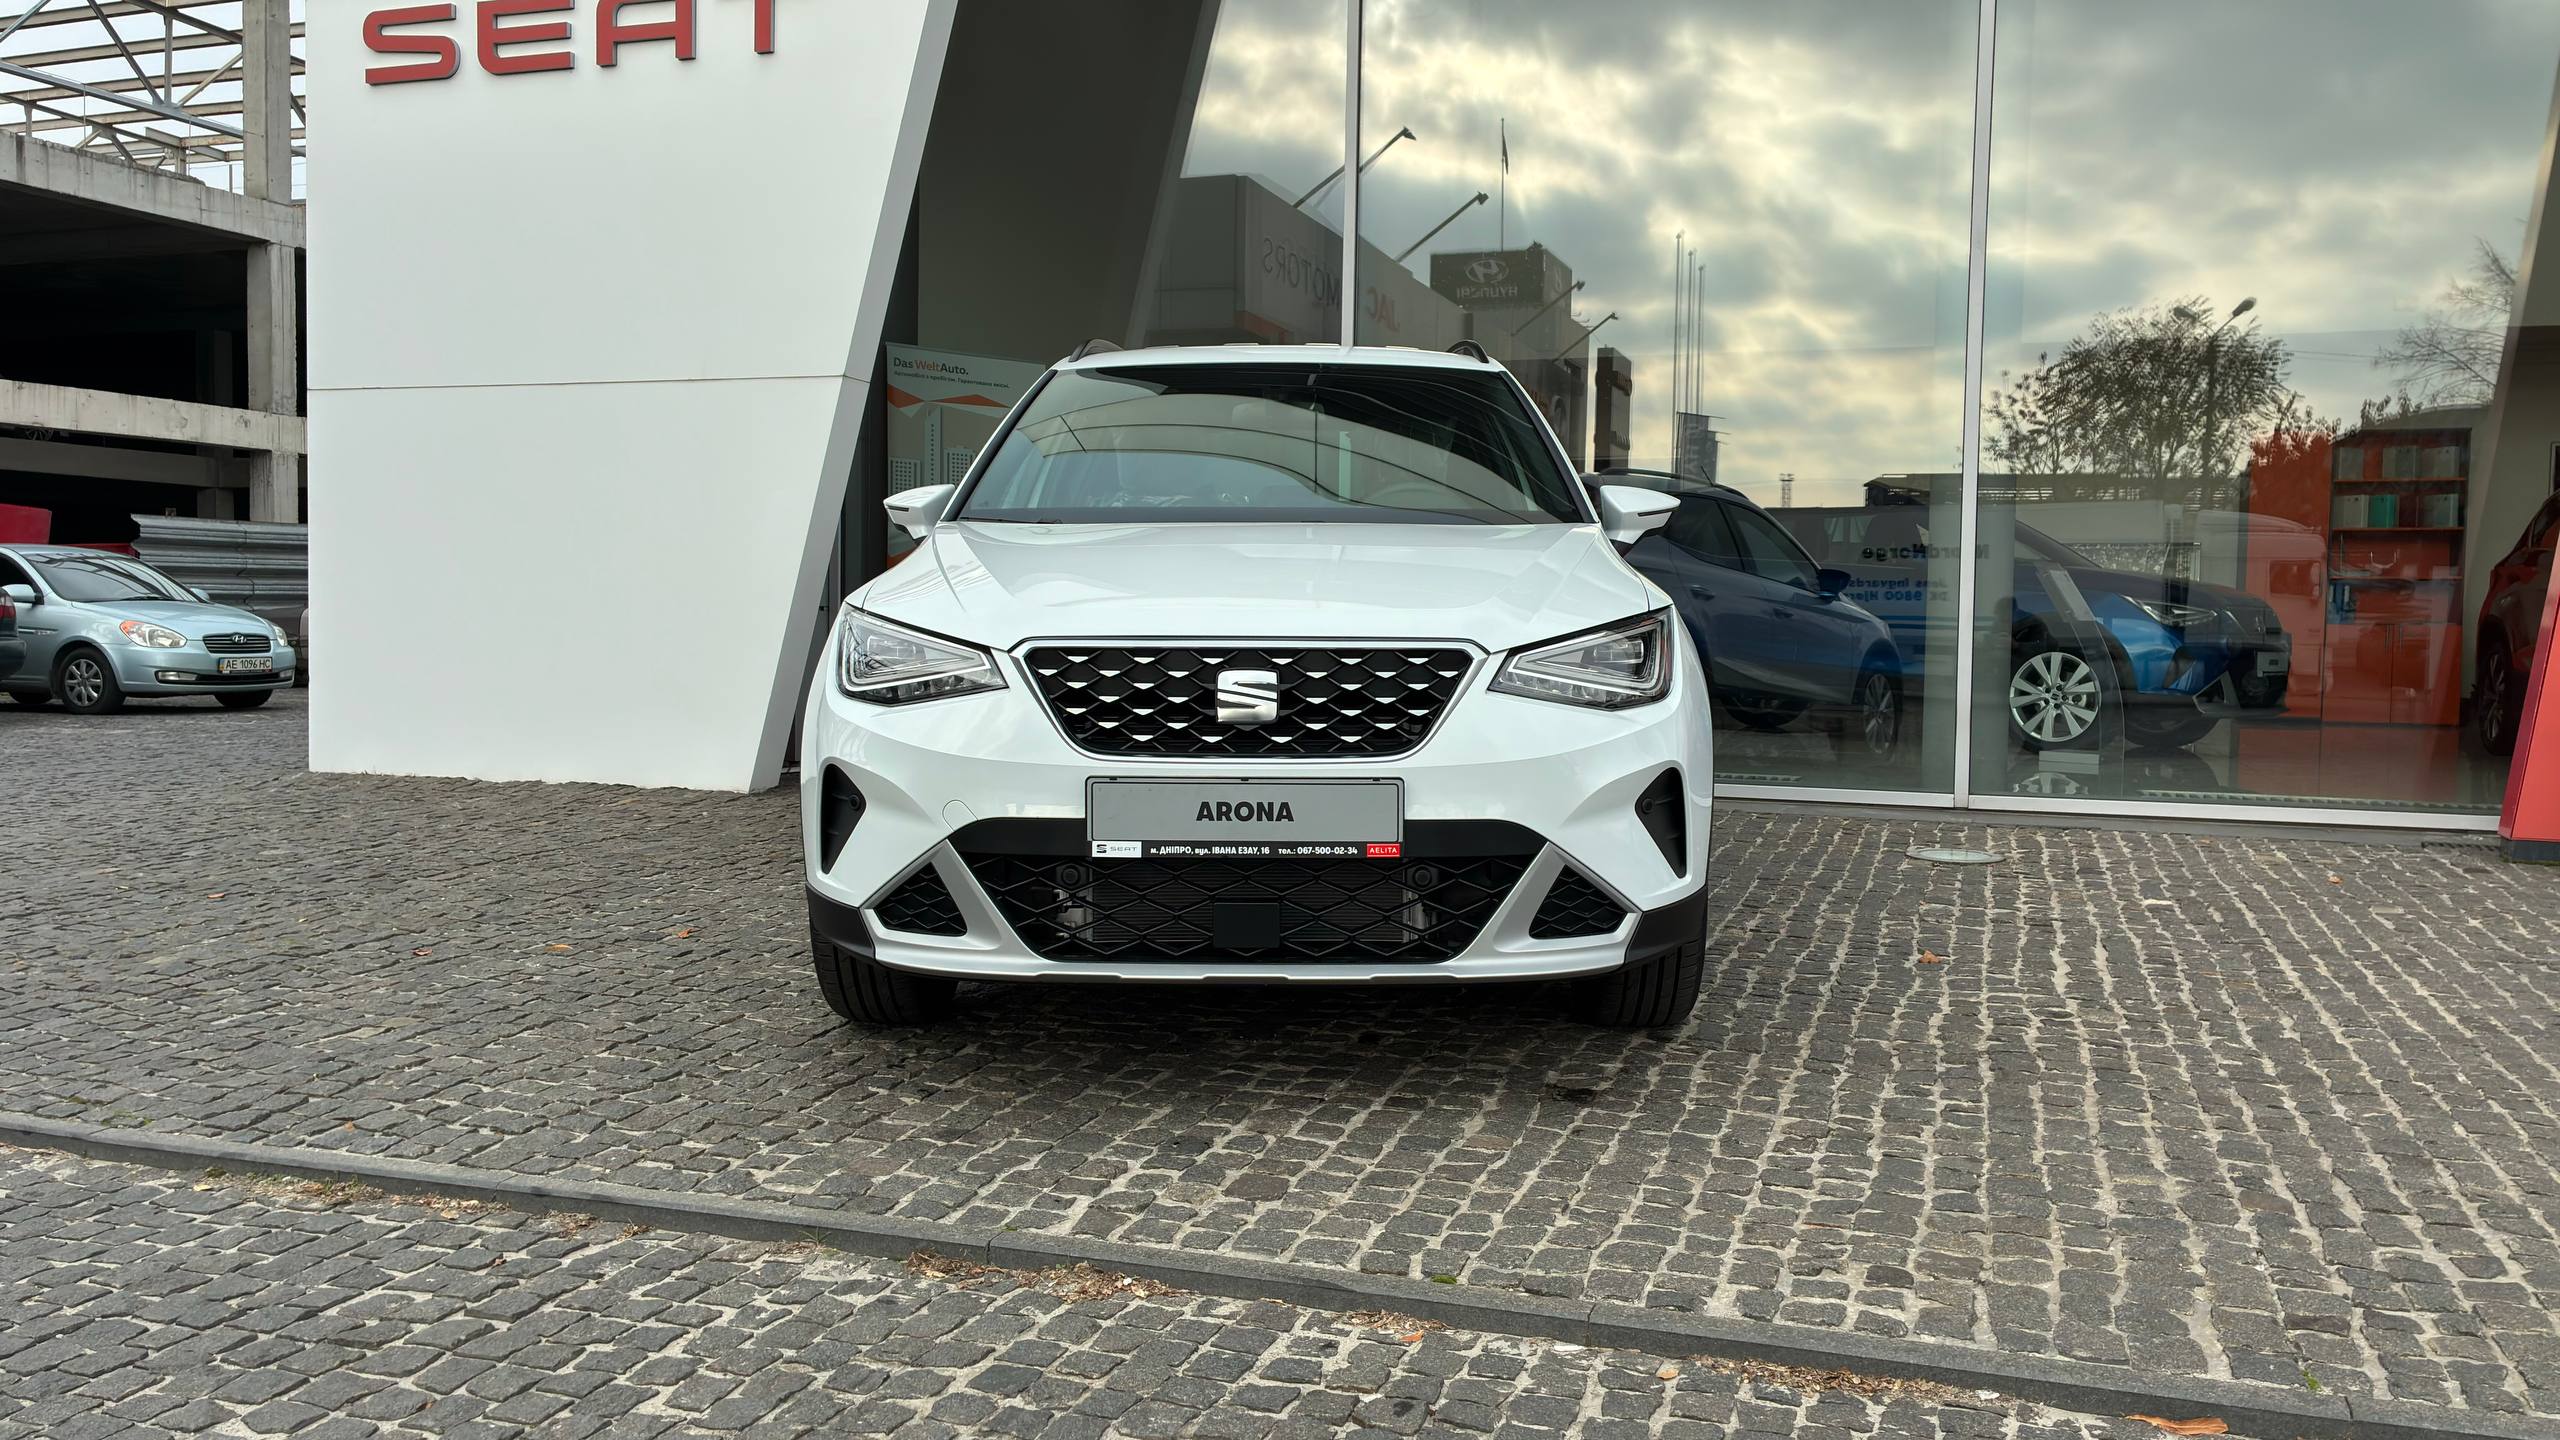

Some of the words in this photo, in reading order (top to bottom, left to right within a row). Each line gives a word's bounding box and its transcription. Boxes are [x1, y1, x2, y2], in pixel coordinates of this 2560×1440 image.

[893, 357, 914, 369] Das
[914, 359, 969, 376] WeltAuto.
[225, 660, 238, 669] AE
[240, 659, 258, 669] 1096
[259, 659, 271, 668] HC
[1196, 801, 1295, 822] ARONA
[1159, 846, 1193, 855] ДНІПРО,
[1194, 848, 1211, 856] вул.
[1211, 846, 1237, 854] ІВАНА
[1261, 846, 1270, 854] 16
[1278, 847, 1296, 855] тел.:
[1297, 846, 1358, 855] 067-500-02-34
